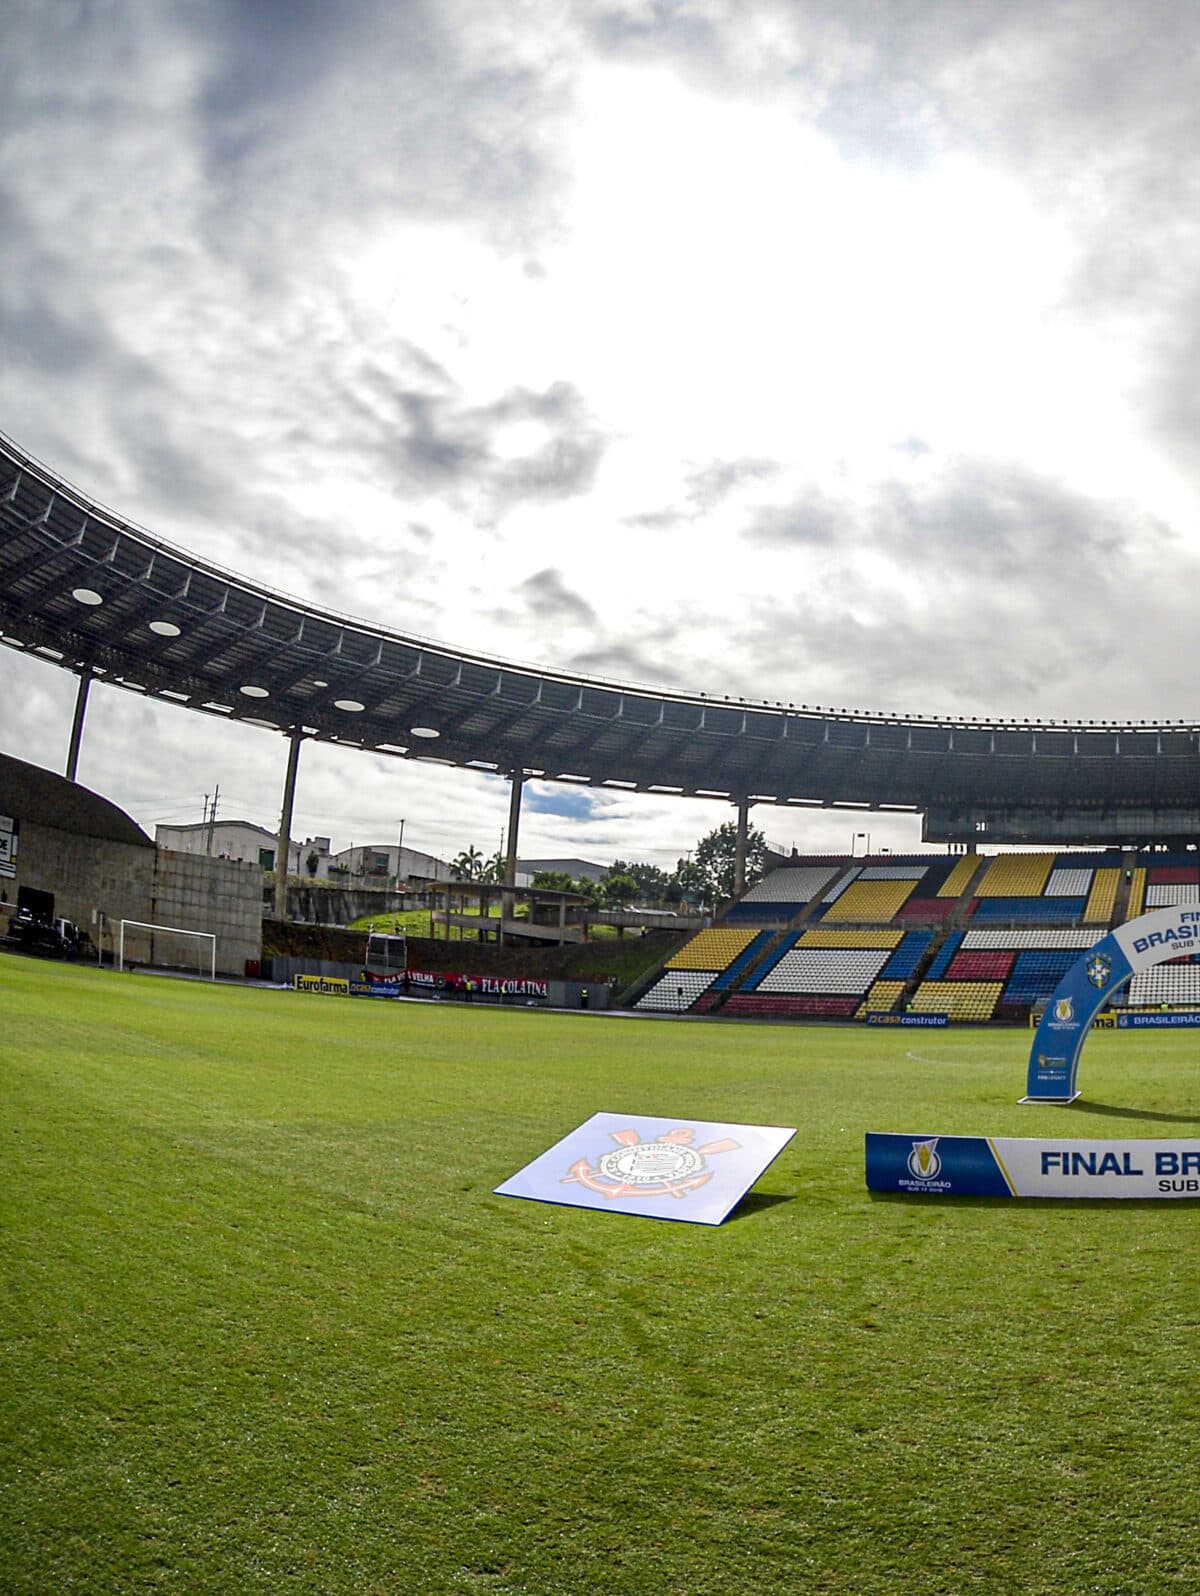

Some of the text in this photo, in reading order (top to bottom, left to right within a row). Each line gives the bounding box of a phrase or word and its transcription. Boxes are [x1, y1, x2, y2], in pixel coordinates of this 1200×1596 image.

[1171, 940, 1194, 950] SUB
[296, 975, 348, 994] Eurofarma
[482, 978, 547, 996] FLA COLATINA
[901, 1016, 946, 1025] construtor
[1041, 1151, 1143, 1176] FINAL
[898, 1179, 952, 1189] BRASILEIRÃO
[1158, 1180, 1199, 1192] SUB
